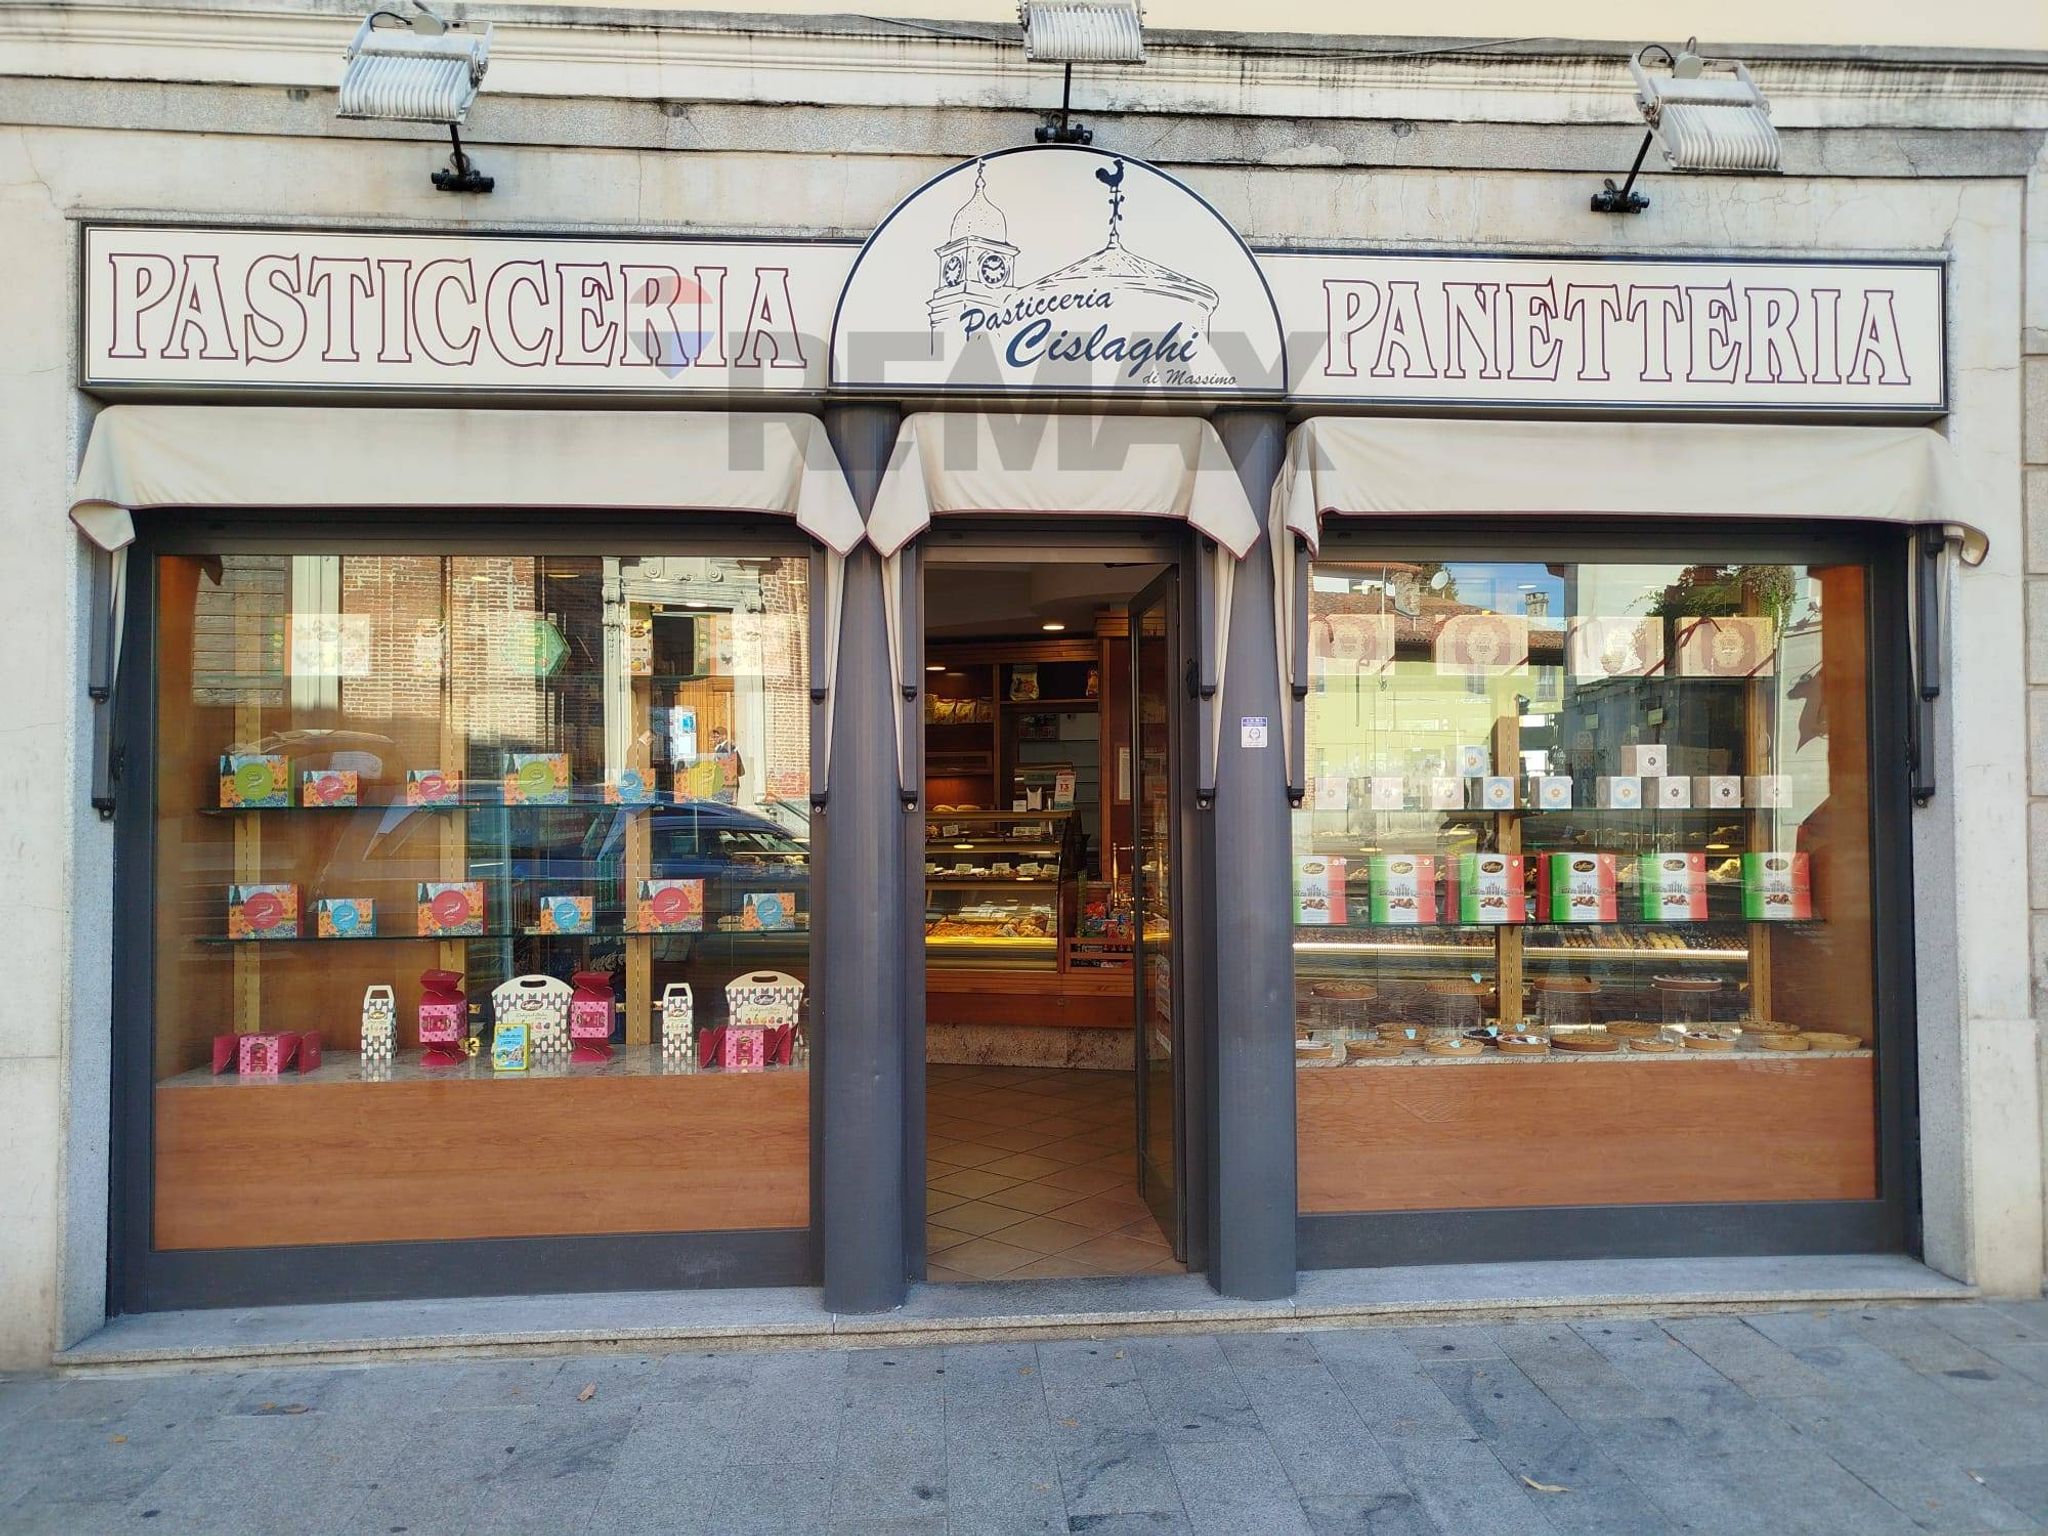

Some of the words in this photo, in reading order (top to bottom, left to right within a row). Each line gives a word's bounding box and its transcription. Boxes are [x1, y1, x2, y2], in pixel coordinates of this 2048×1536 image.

[107, 252, 808, 368] PASTICCERIA
[960, 288, 1114, 342] Pasticceria
[1322, 275, 1911, 385] PANETTERIA
[1005, 317, 1199, 378] Cislaghi
[1142, 369, 1159, 384] di
[1166, 369, 1237, 385] Massimo
